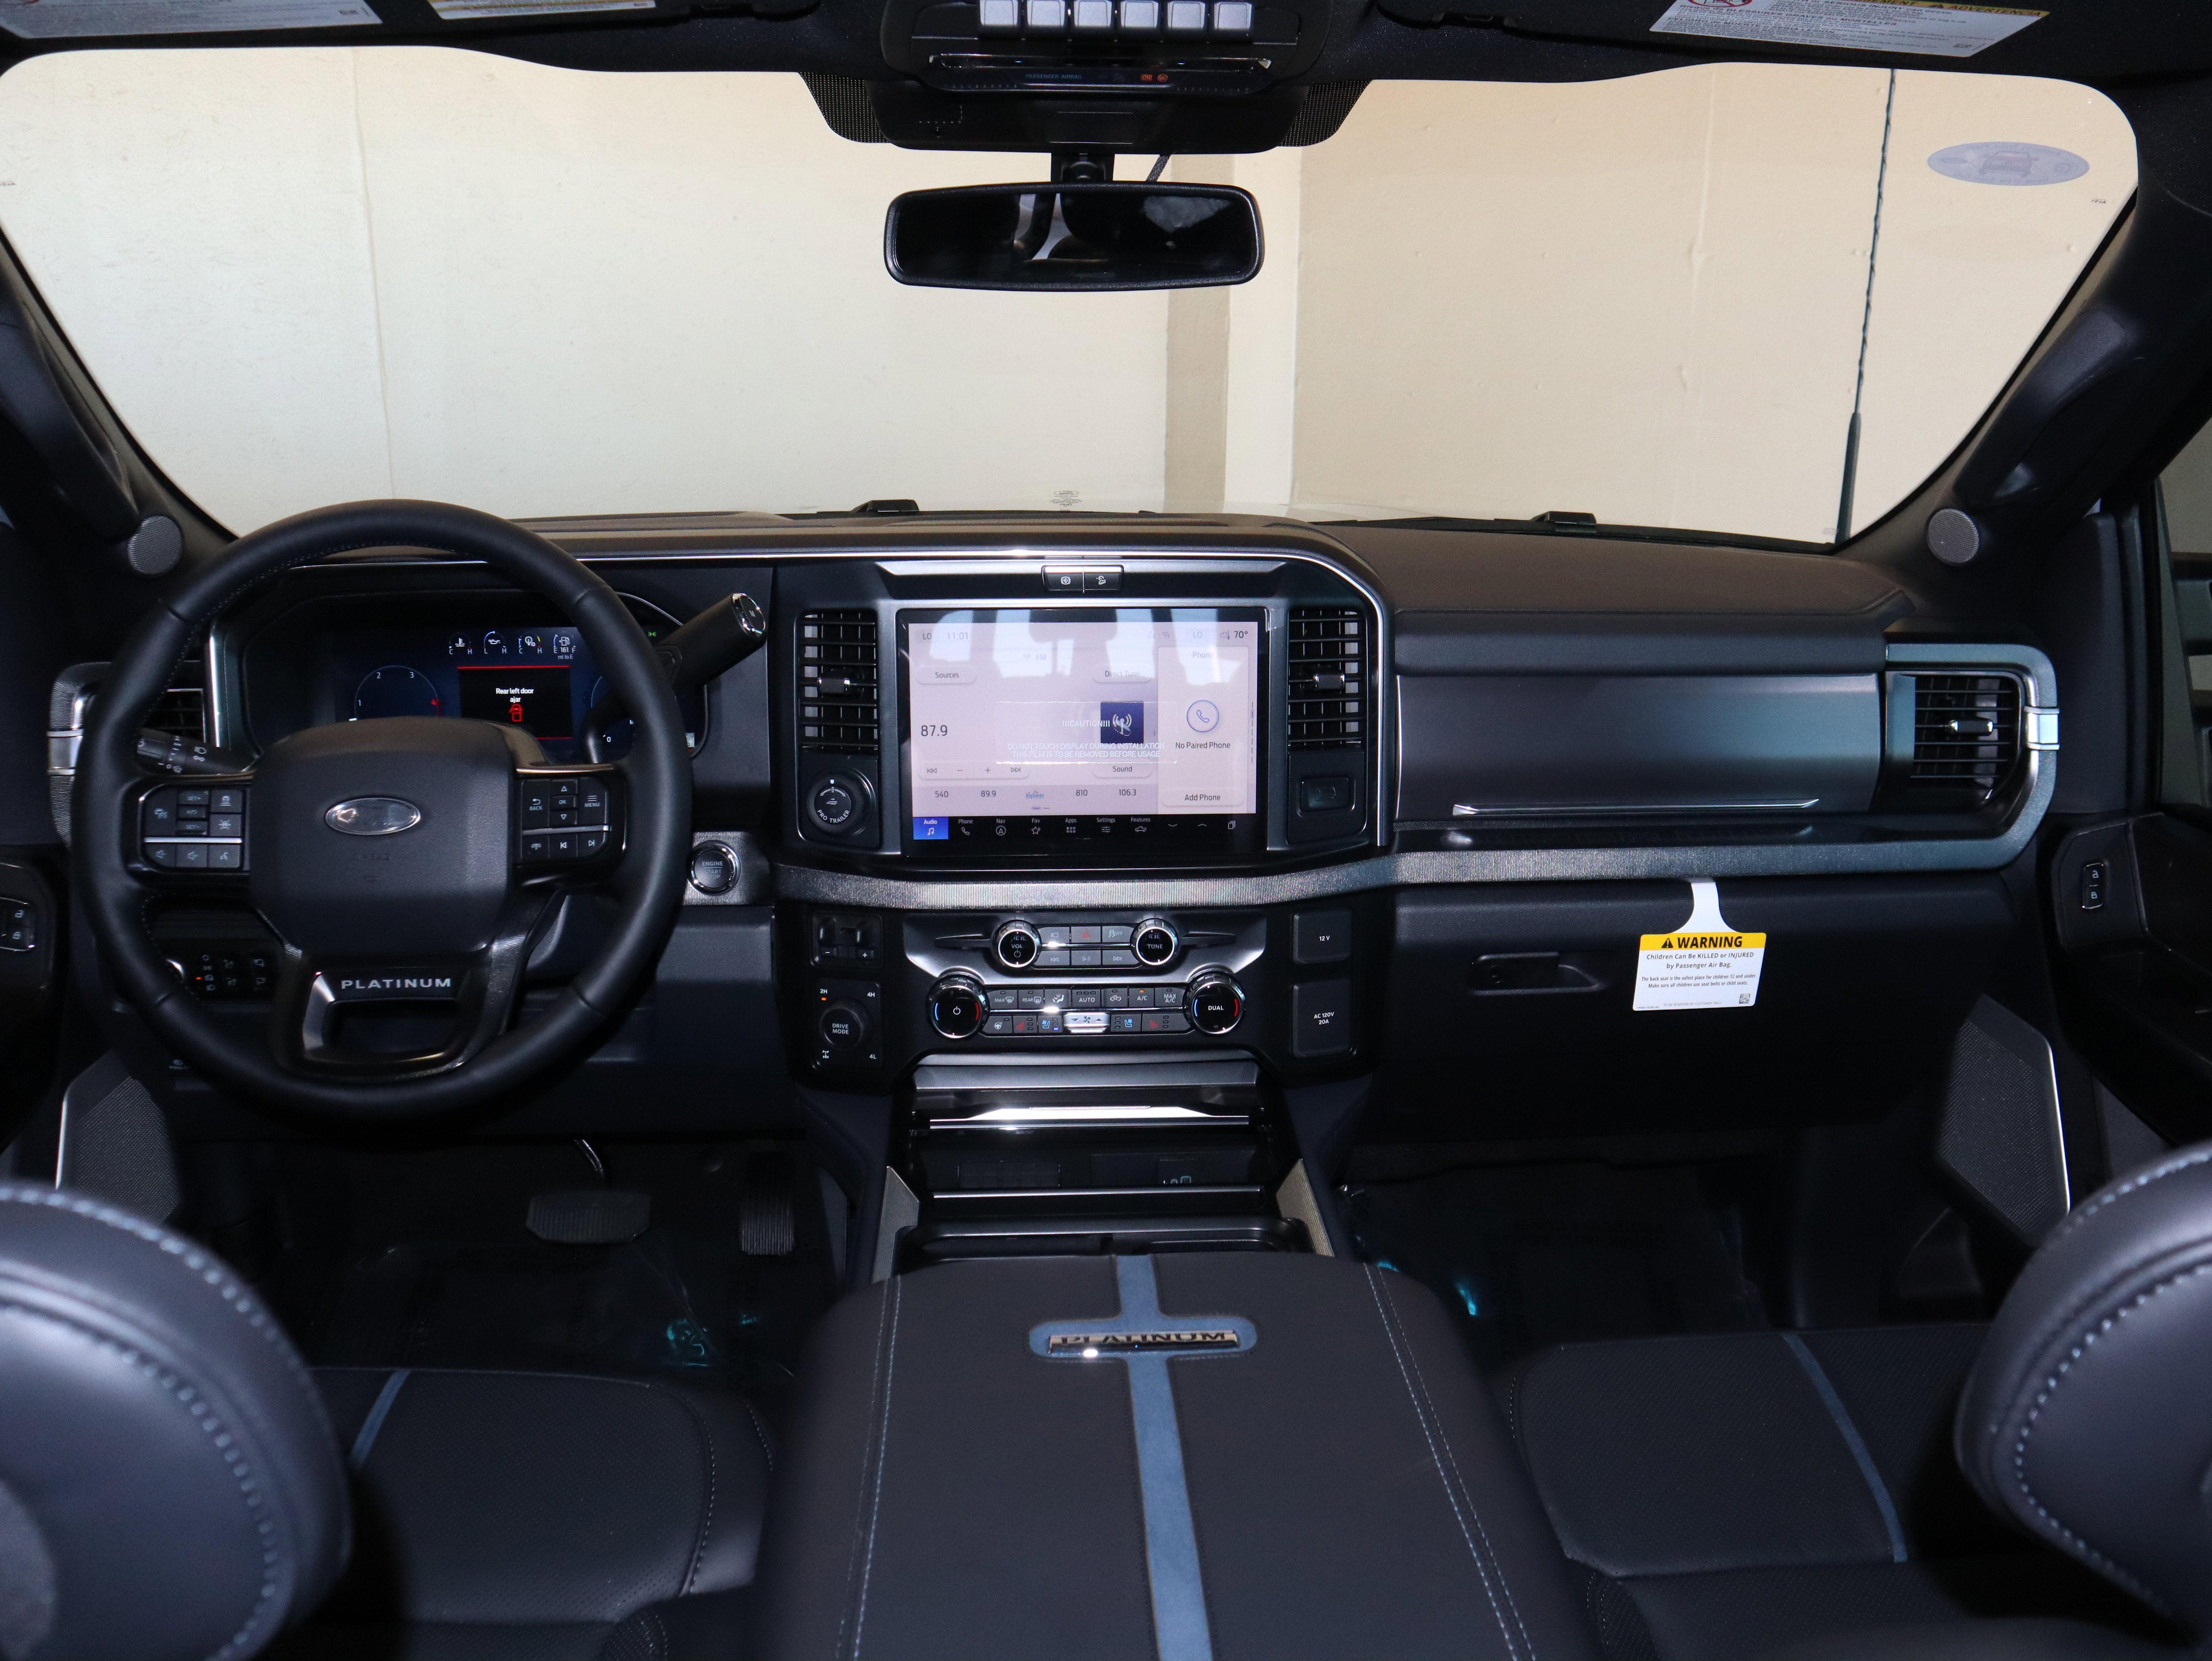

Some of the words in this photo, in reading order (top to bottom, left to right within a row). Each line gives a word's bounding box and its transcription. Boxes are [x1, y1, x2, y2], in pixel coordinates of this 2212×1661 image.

[947, 632, 969, 640] 11:01
[1234, 630, 1248, 639] 70°
[921, 725, 948, 737] 87.9
[817, 809, 828, 821] PRO
[829, 810, 850, 823] TRAILER
[1677, 936, 1743, 948] WARNING
[341, 978, 451, 989] PLATINUM
[1061, 1332, 1226, 1345] PLATINUM
